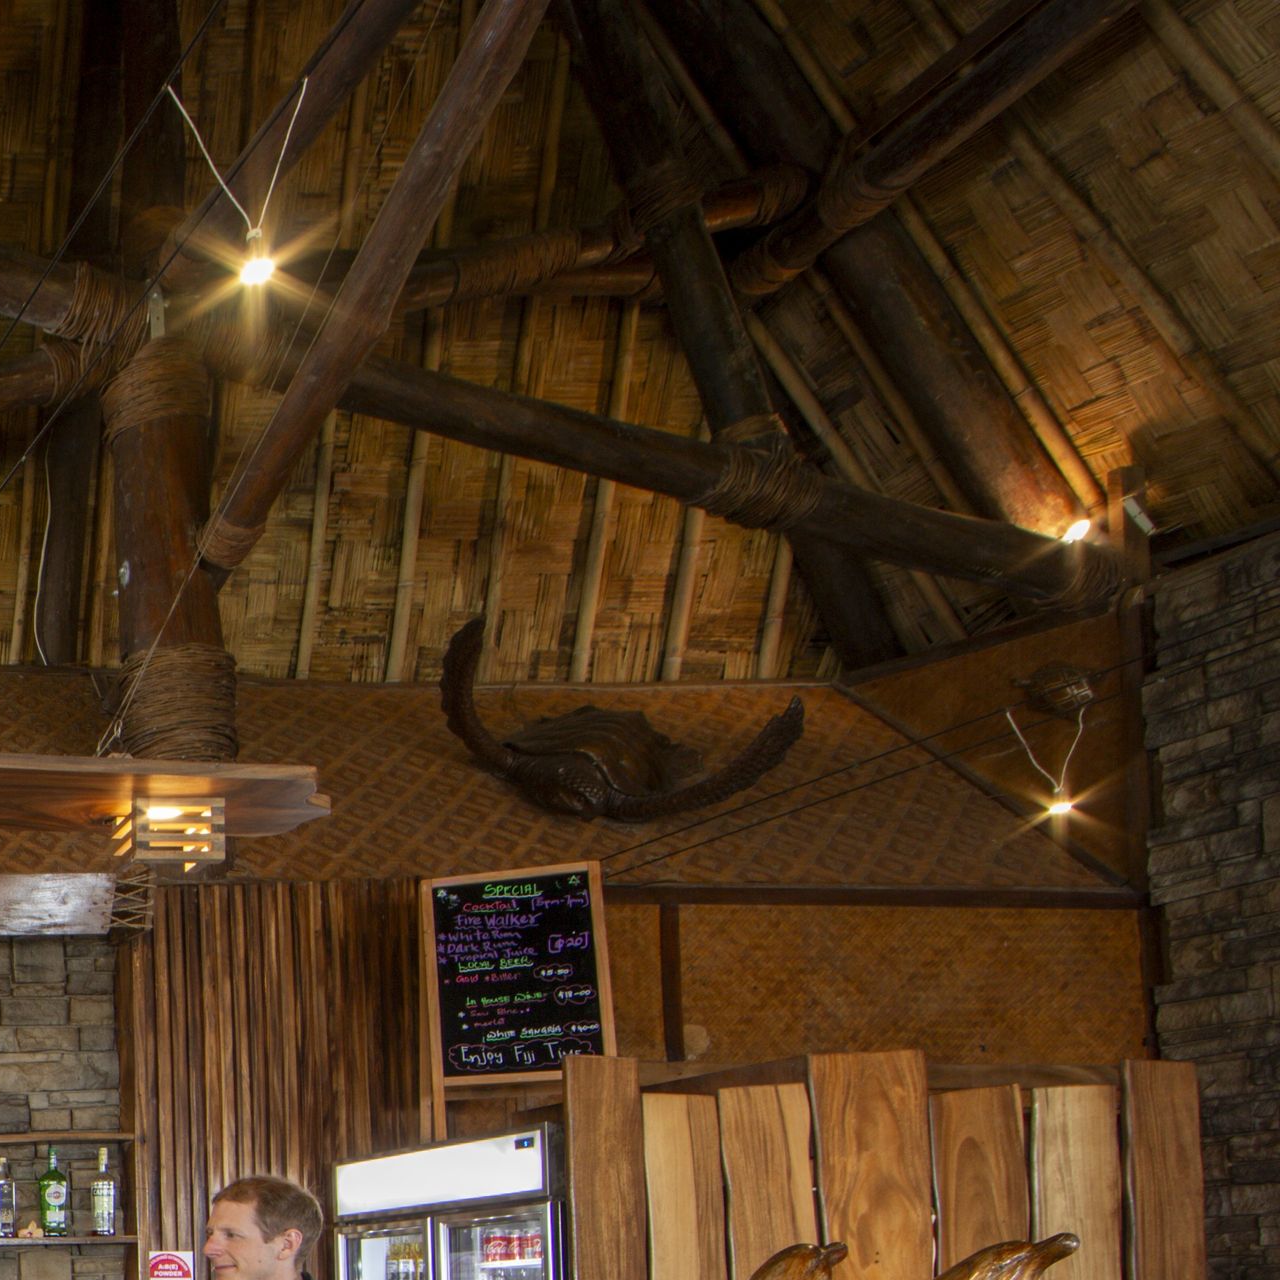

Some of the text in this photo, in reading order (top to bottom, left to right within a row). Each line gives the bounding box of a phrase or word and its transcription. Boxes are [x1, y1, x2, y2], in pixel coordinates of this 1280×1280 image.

[484, 883, 542, 897] SPECIAL
[485, 912, 543, 927] Walker
[500, 957, 530, 969] BEER
[461, 1045, 503, 1066] Enjoy
